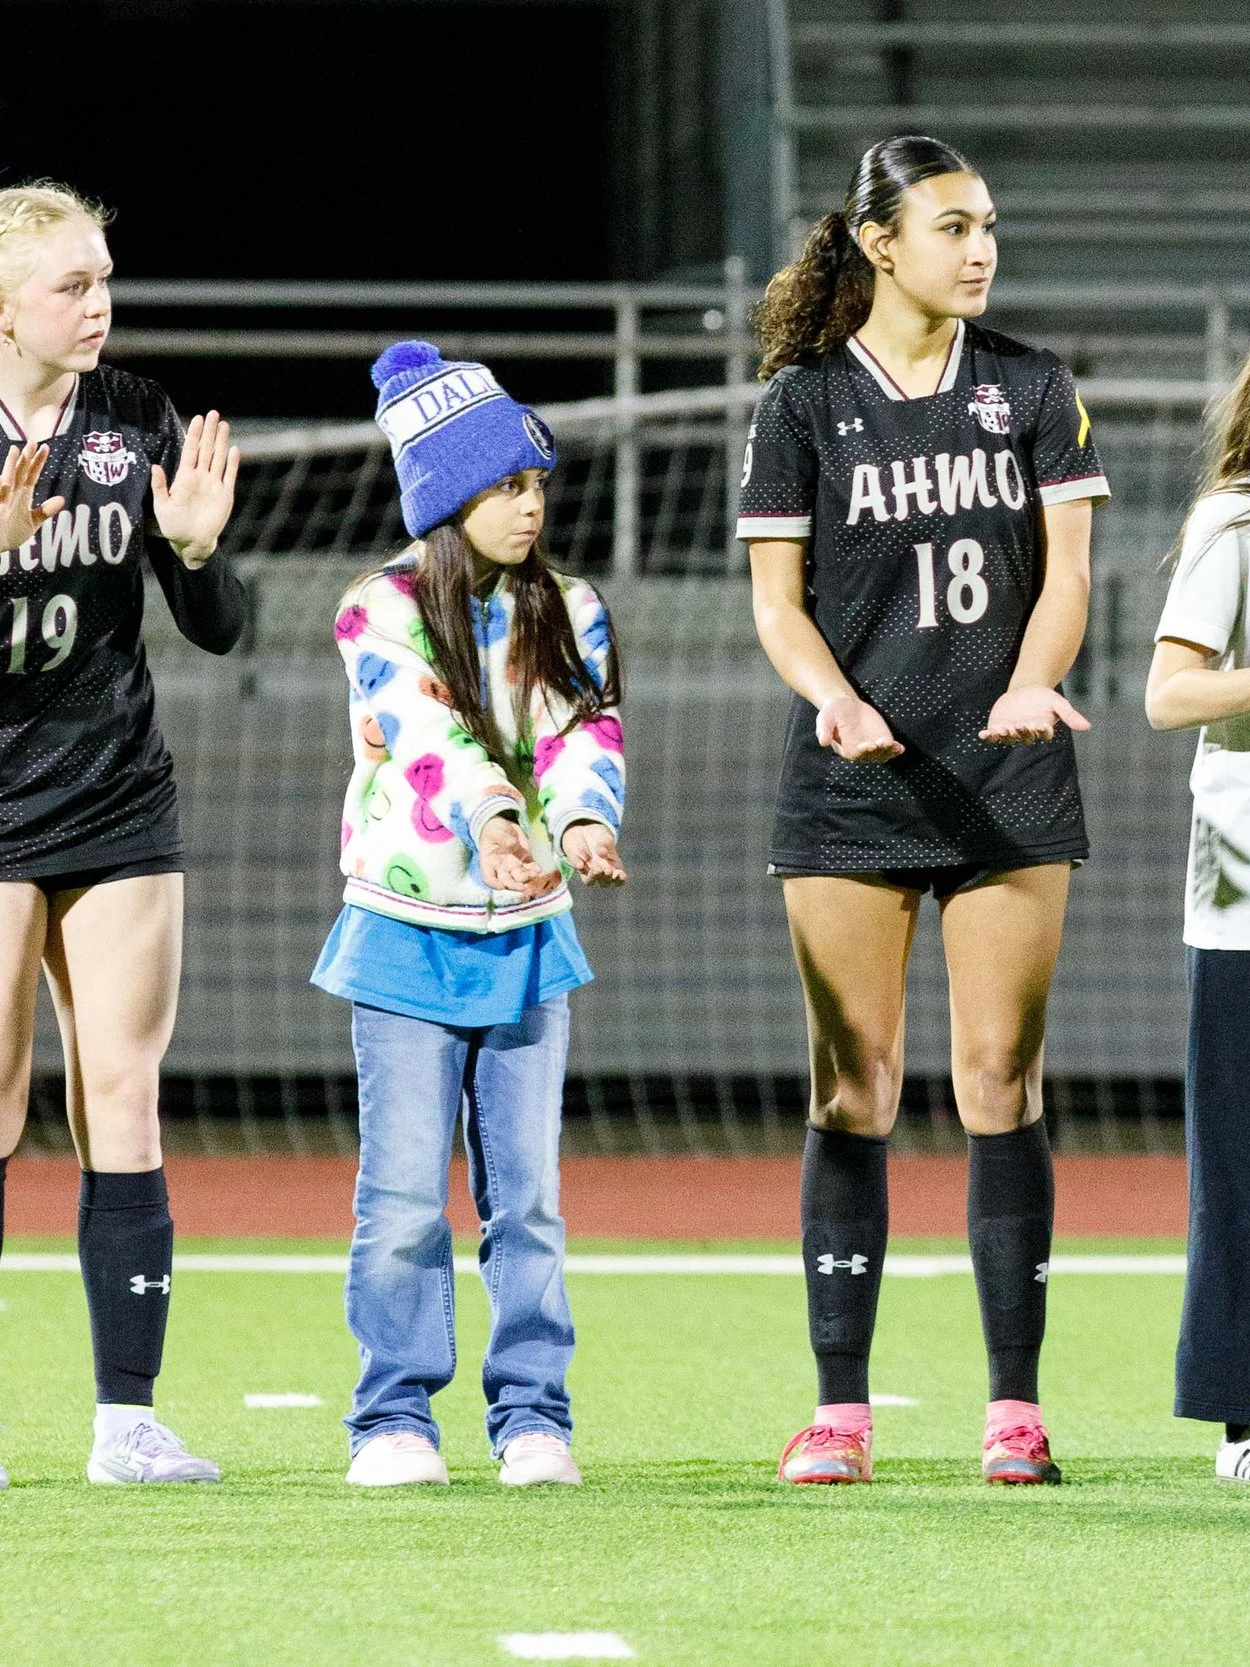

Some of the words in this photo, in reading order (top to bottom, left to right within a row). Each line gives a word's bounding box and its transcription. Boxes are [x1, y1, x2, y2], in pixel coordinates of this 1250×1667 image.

[846, 449, 1025, 525] AHMO
[0, 501, 133, 575] MO
[913, 538, 989, 628] 18
[7, 594, 78, 675] 19
